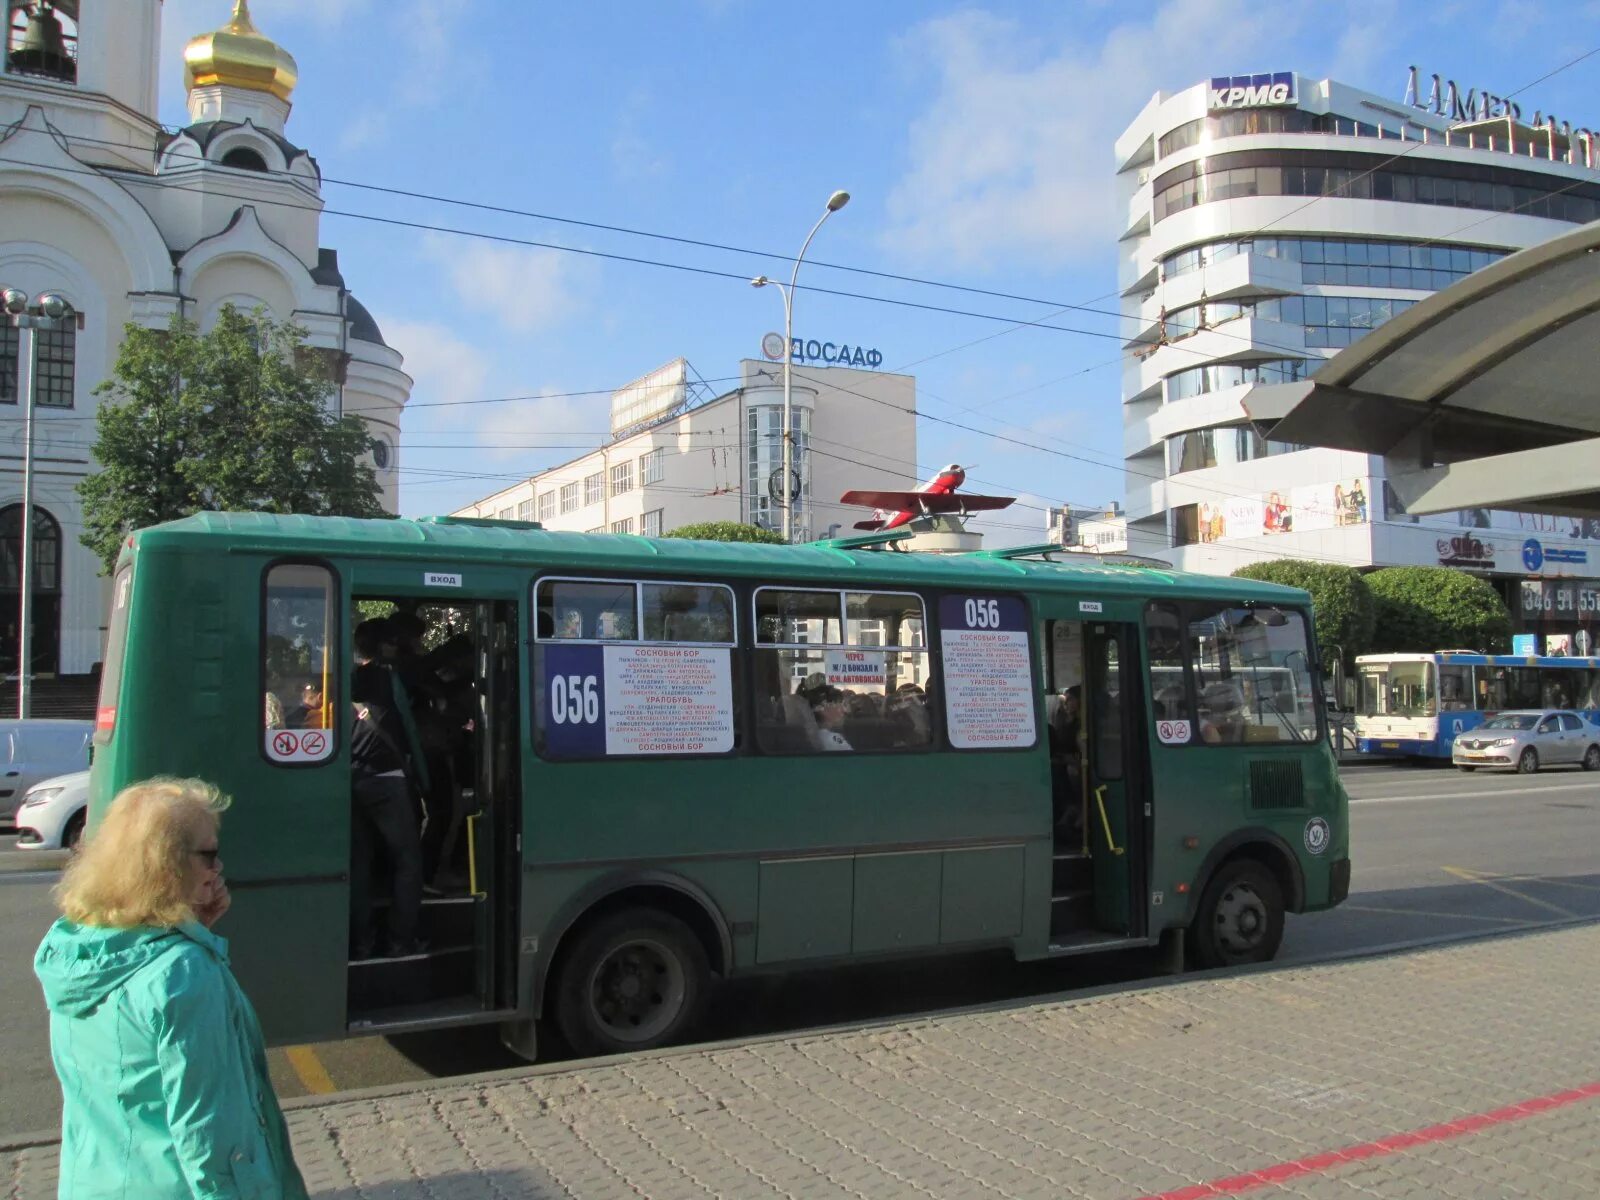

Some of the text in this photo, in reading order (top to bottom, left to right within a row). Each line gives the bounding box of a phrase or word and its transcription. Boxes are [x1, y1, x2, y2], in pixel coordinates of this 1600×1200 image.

[1207, 83, 1289, 109] KPMG
[790, 337, 883, 368] ДОСААФ
[430, 575, 457, 585] ВХОД
[1525, 589, 1552, 611] 346
[965, 598, 1000, 628] 056
[846, 653, 865, 661] ЧЕРЕЗ
[848, 663, 873, 673] ВОКЗАЛ
[843, 675, 884, 684] АВТОВОКЗАЛ
[551, 674, 599, 724] 056
[638, 743, 685, 751] СОСНОВЫЙ
